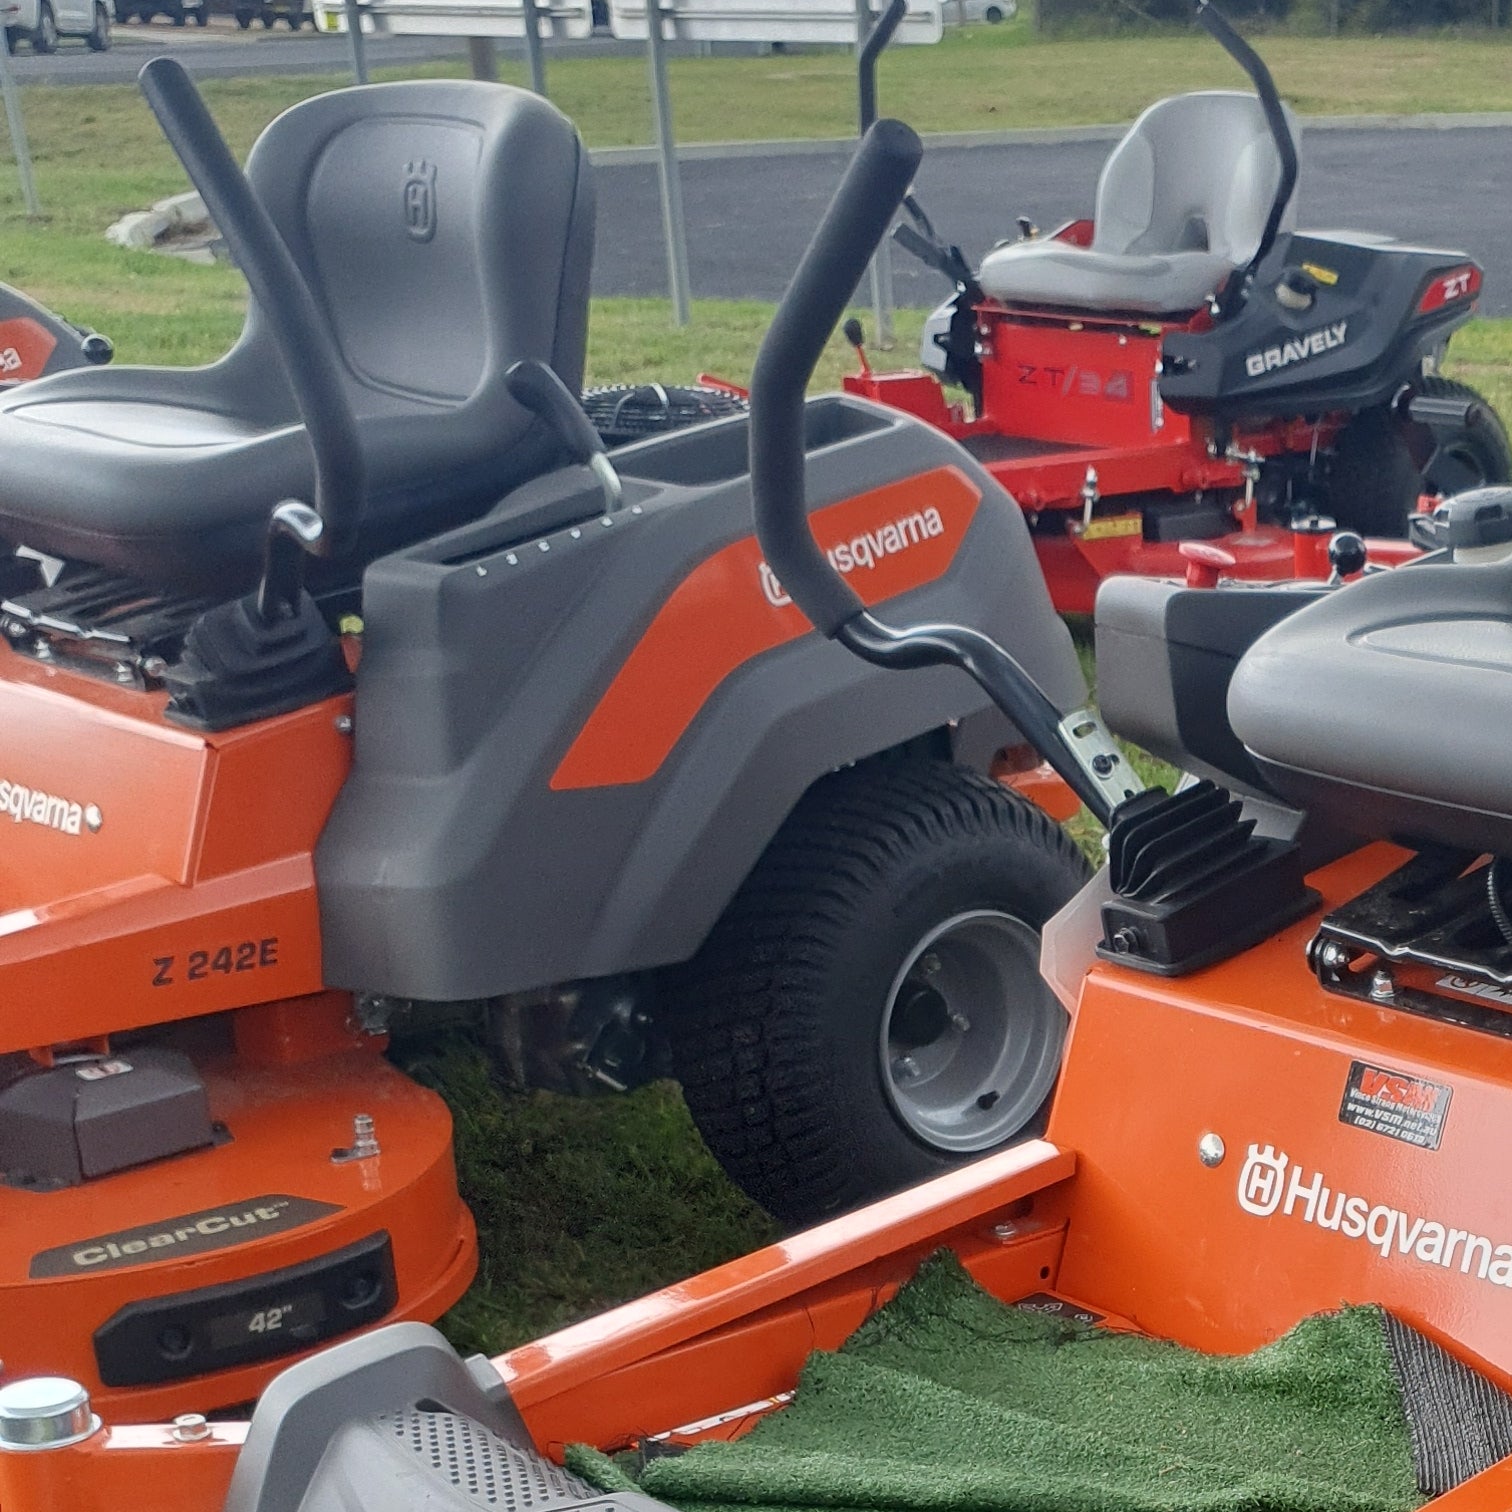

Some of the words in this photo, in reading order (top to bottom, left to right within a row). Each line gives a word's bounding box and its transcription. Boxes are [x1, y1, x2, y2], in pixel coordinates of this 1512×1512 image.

[1443, 273, 1471, 299] ZT
[1246, 320, 1347, 377] GRAVELY
[152, 956, 175, 987] Z
[187, 937, 279, 981] 242E
[1360, 1067, 1440, 1114] VSM
